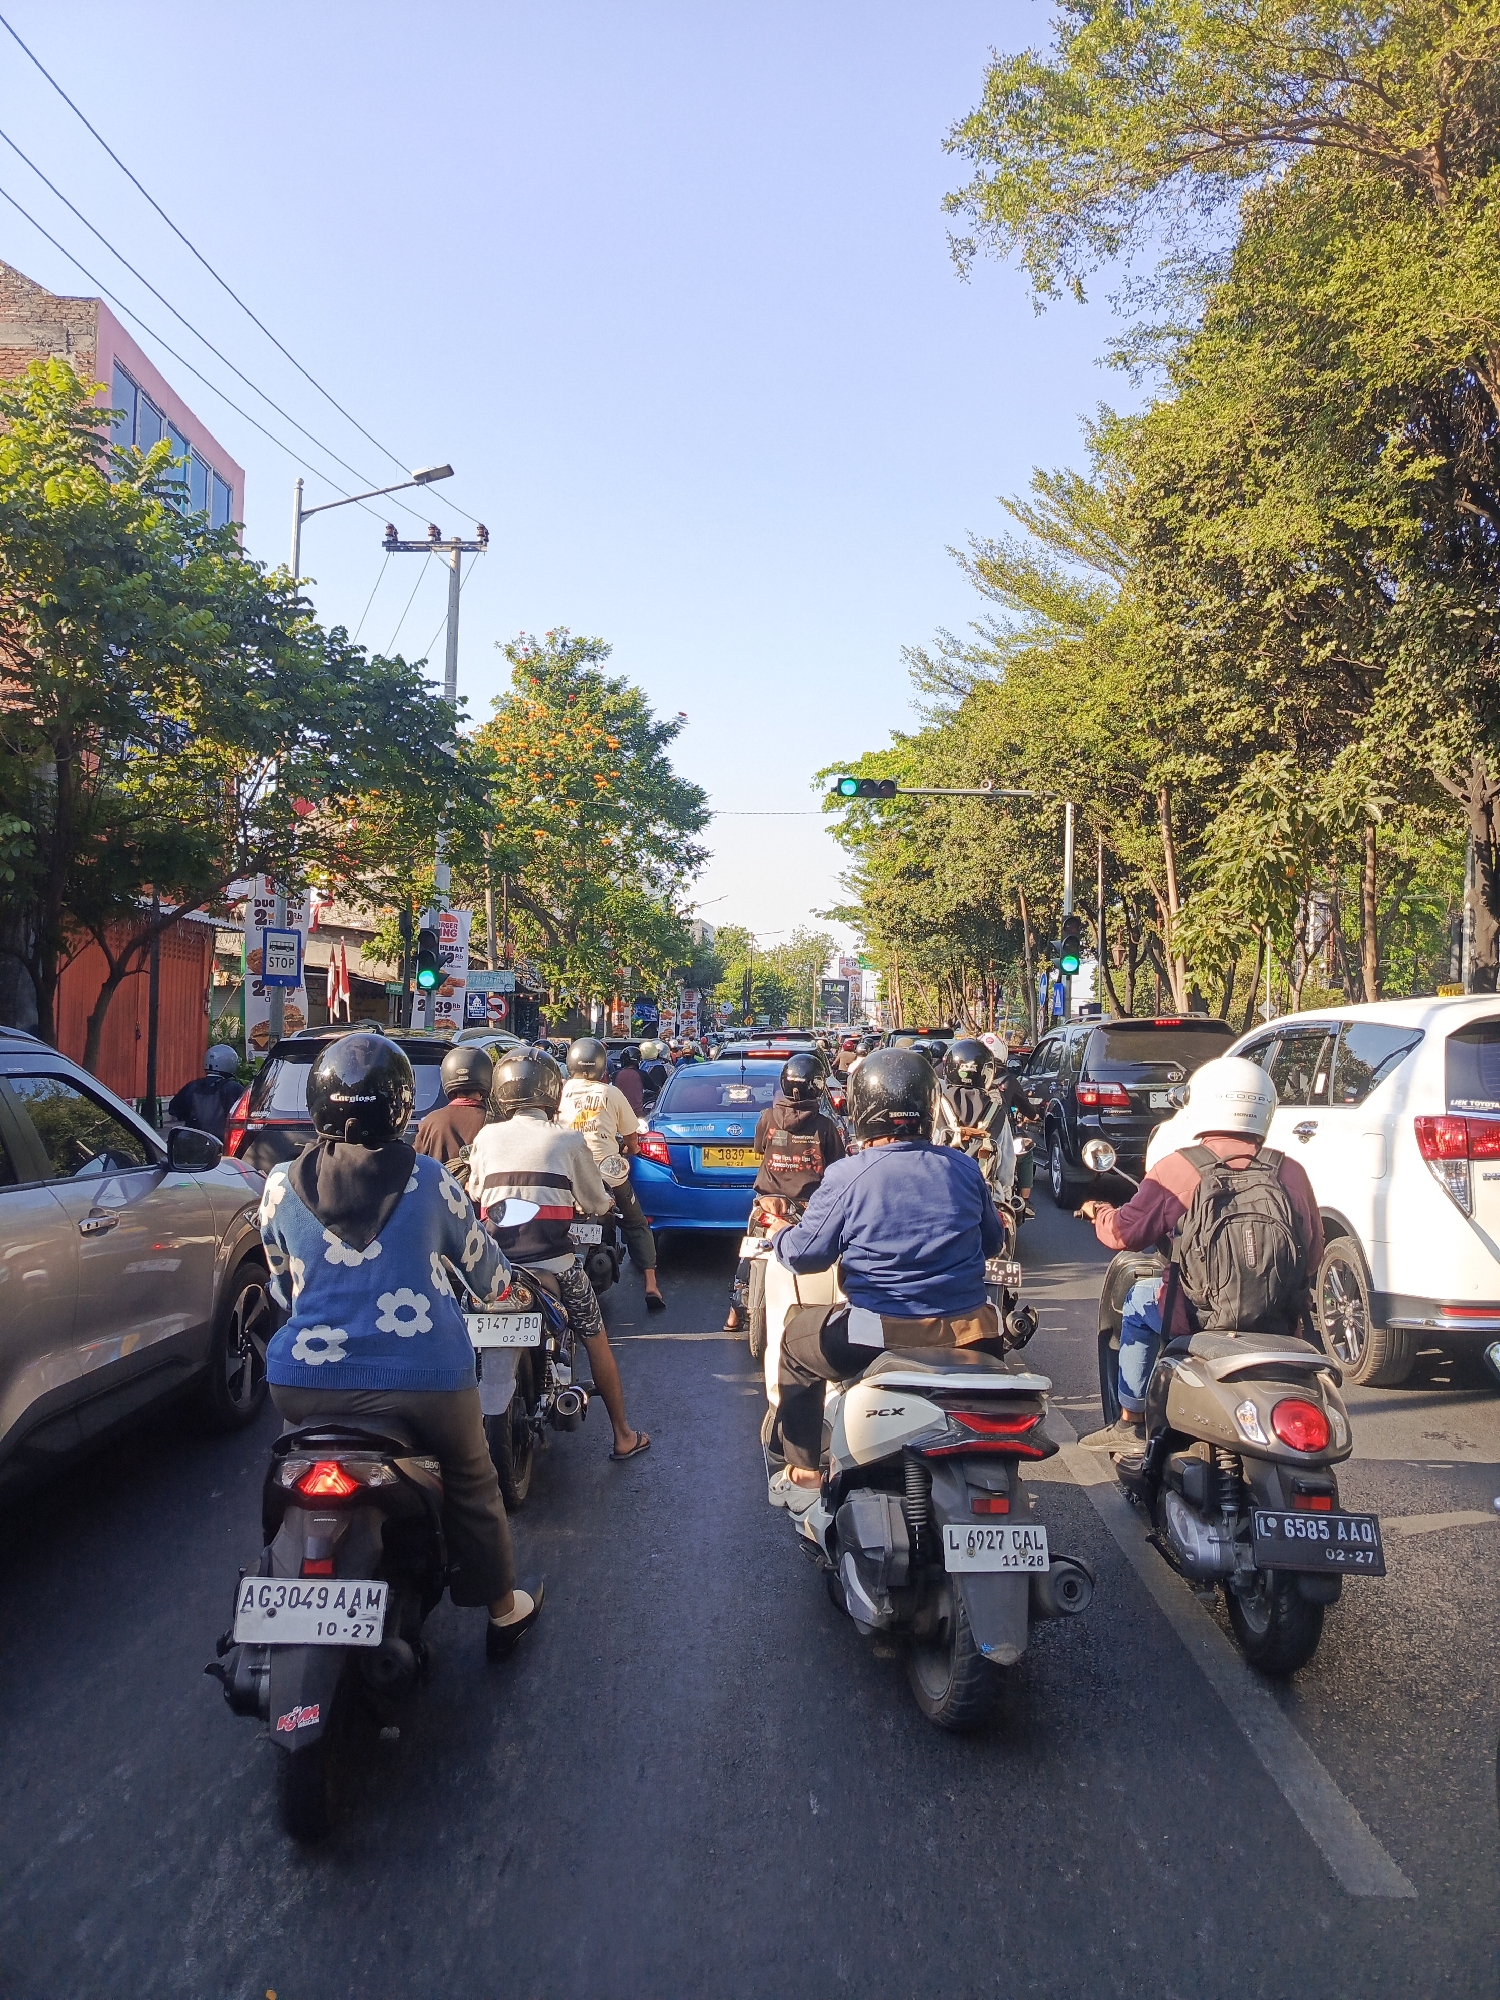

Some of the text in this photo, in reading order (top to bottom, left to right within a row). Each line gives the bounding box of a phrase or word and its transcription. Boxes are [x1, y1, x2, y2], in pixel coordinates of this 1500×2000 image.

[439, 921, 458, 930] RGER
[439, 928, 458, 938] ING
[268, 957, 295, 969] STOP
[435, 1001, 452, 1013] 39
[330, 1091, 377, 1103] Cargloss
[1469, 1100, 1500, 1108] TOYOTA
[703, 1148, 710, 1160] W
[718, 1148, 745, 1161] 1839
[985, 1261, 998, 1272] 54
[477, 1317, 509, 1330] 5147
[866, 1407, 906, 1418] PCX
[1259, 1516, 1272, 1537] L
[1284, 1518, 1330, 1540] 6585
[949, 1529, 1044, 1550] L 6927 CAL
